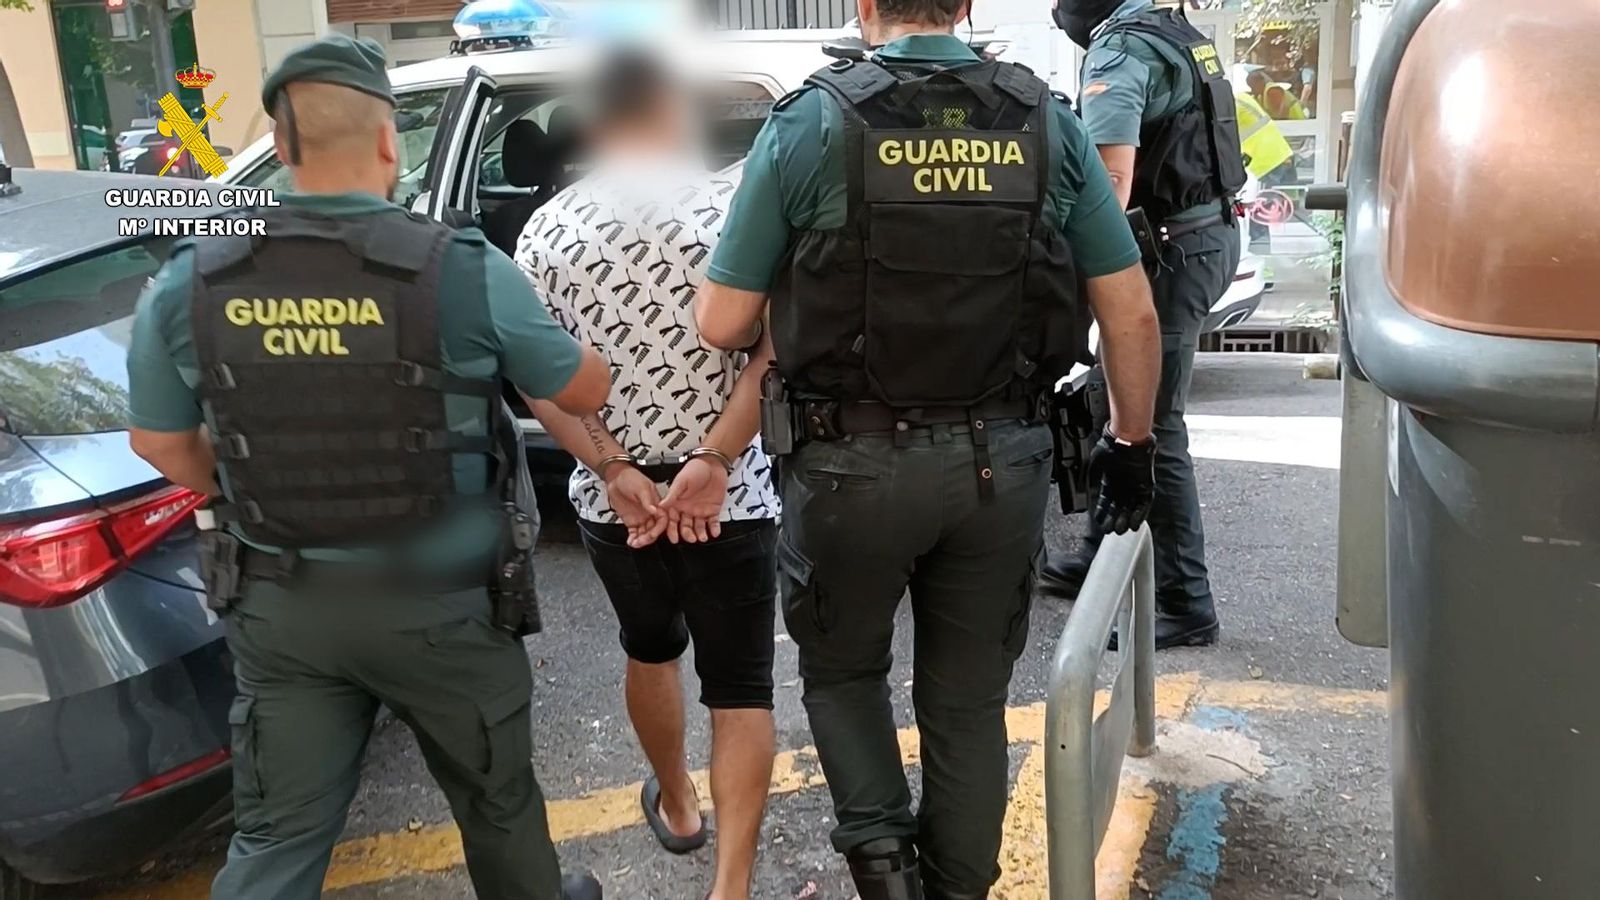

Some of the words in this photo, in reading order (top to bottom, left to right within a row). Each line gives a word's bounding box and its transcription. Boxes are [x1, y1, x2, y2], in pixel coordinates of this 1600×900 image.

[878, 138, 1025, 165] GUARDIA
[913, 167, 993, 193] CIVIL
[224, 298, 384, 326] GUARDIA
[263, 328, 349, 356] CIVIL
